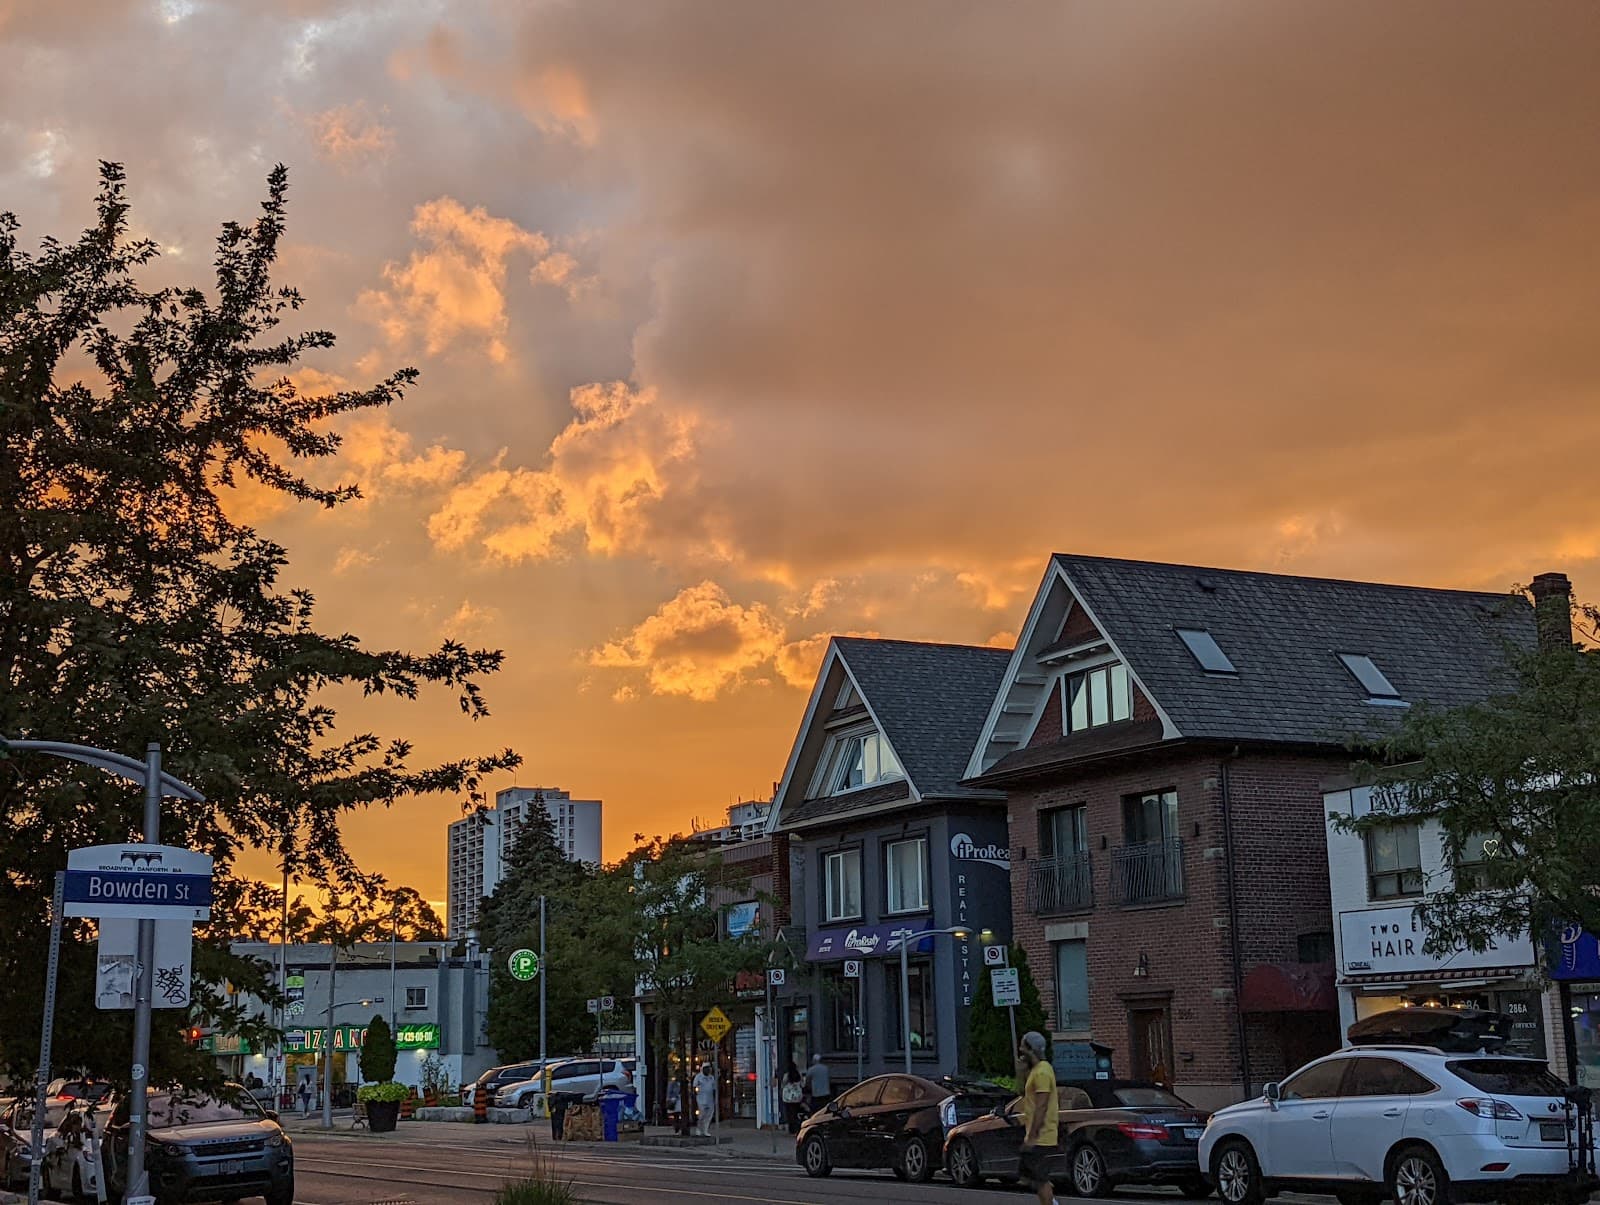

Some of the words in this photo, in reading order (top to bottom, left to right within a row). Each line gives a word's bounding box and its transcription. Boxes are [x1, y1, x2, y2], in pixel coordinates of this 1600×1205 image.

[89, 876, 168, 899] Bowden
[175, 884, 190, 900] St
[958, 874, 967, 923] REAL
[1371, 923, 1399, 936] TWO
[1372, 938, 1416, 958] HAIR
[1508, 1003, 1528, 1014] 286A
